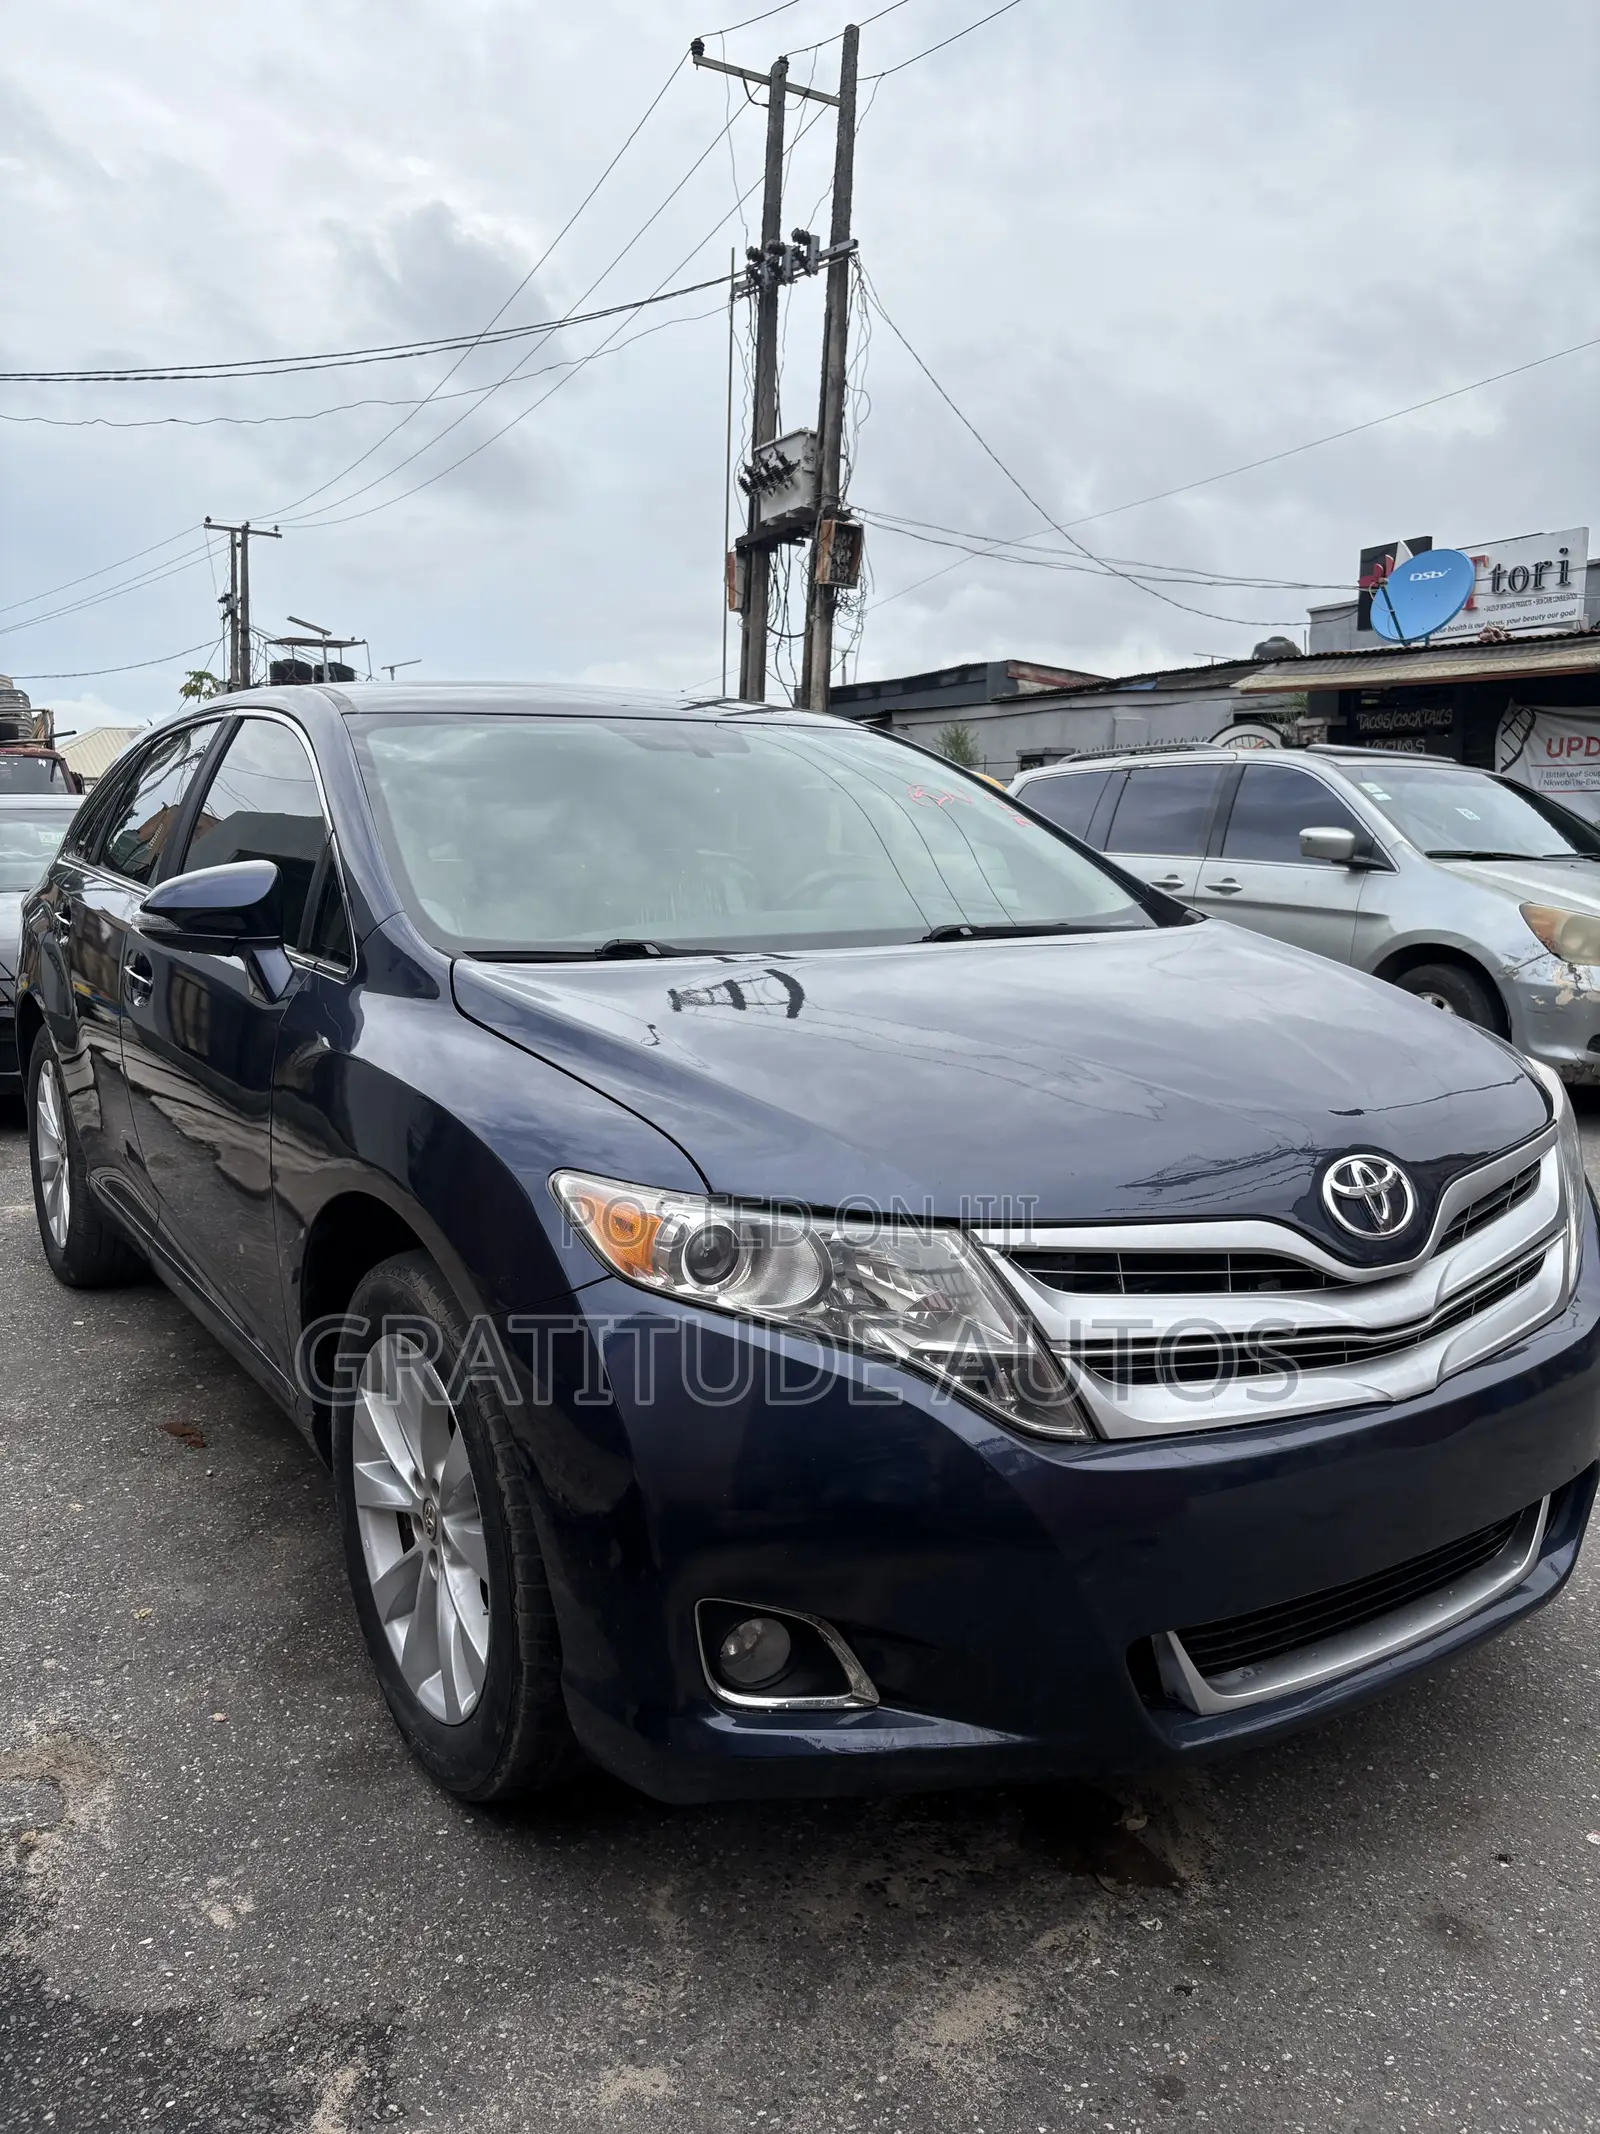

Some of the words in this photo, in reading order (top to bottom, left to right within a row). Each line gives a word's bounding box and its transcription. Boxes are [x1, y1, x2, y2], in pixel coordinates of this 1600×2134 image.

[1447, 623, 1467, 633] health
[1505, 616, 1521, 626] your
[1522, 613, 1546, 623] beauty
[1546, 611, 1559, 620] our
[1559, 608, 1577, 619] goal
